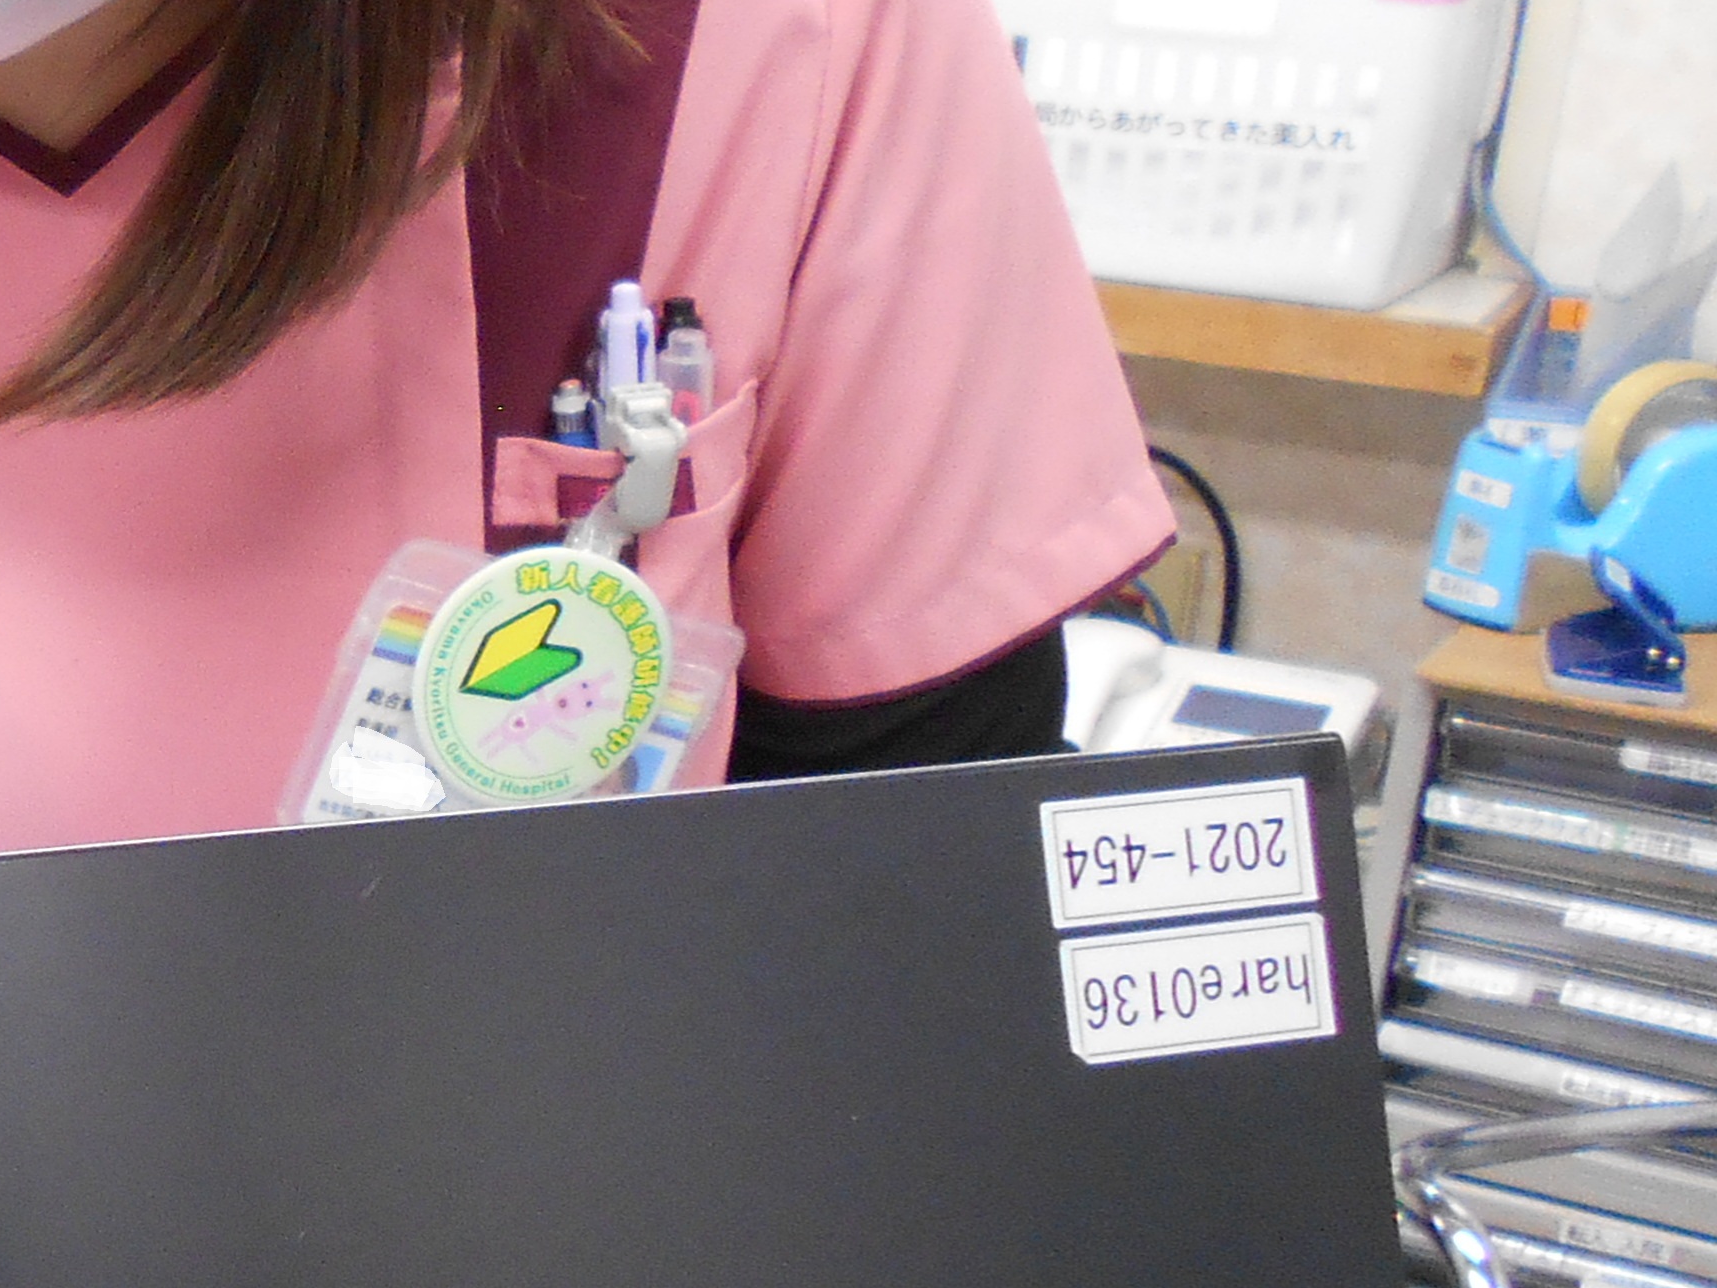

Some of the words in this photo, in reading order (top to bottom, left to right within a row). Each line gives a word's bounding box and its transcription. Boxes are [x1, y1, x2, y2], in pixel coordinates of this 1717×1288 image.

[438, 589, 495, 661] Okayama
[428, 665, 449, 741] Kyoritsu
[444, 741, 496, 789] General
[499, 774, 572, 796] Hospital
[1063, 817, 1288, 890] 2021-454
[1083, 953, 1313, 1030] hare0136
